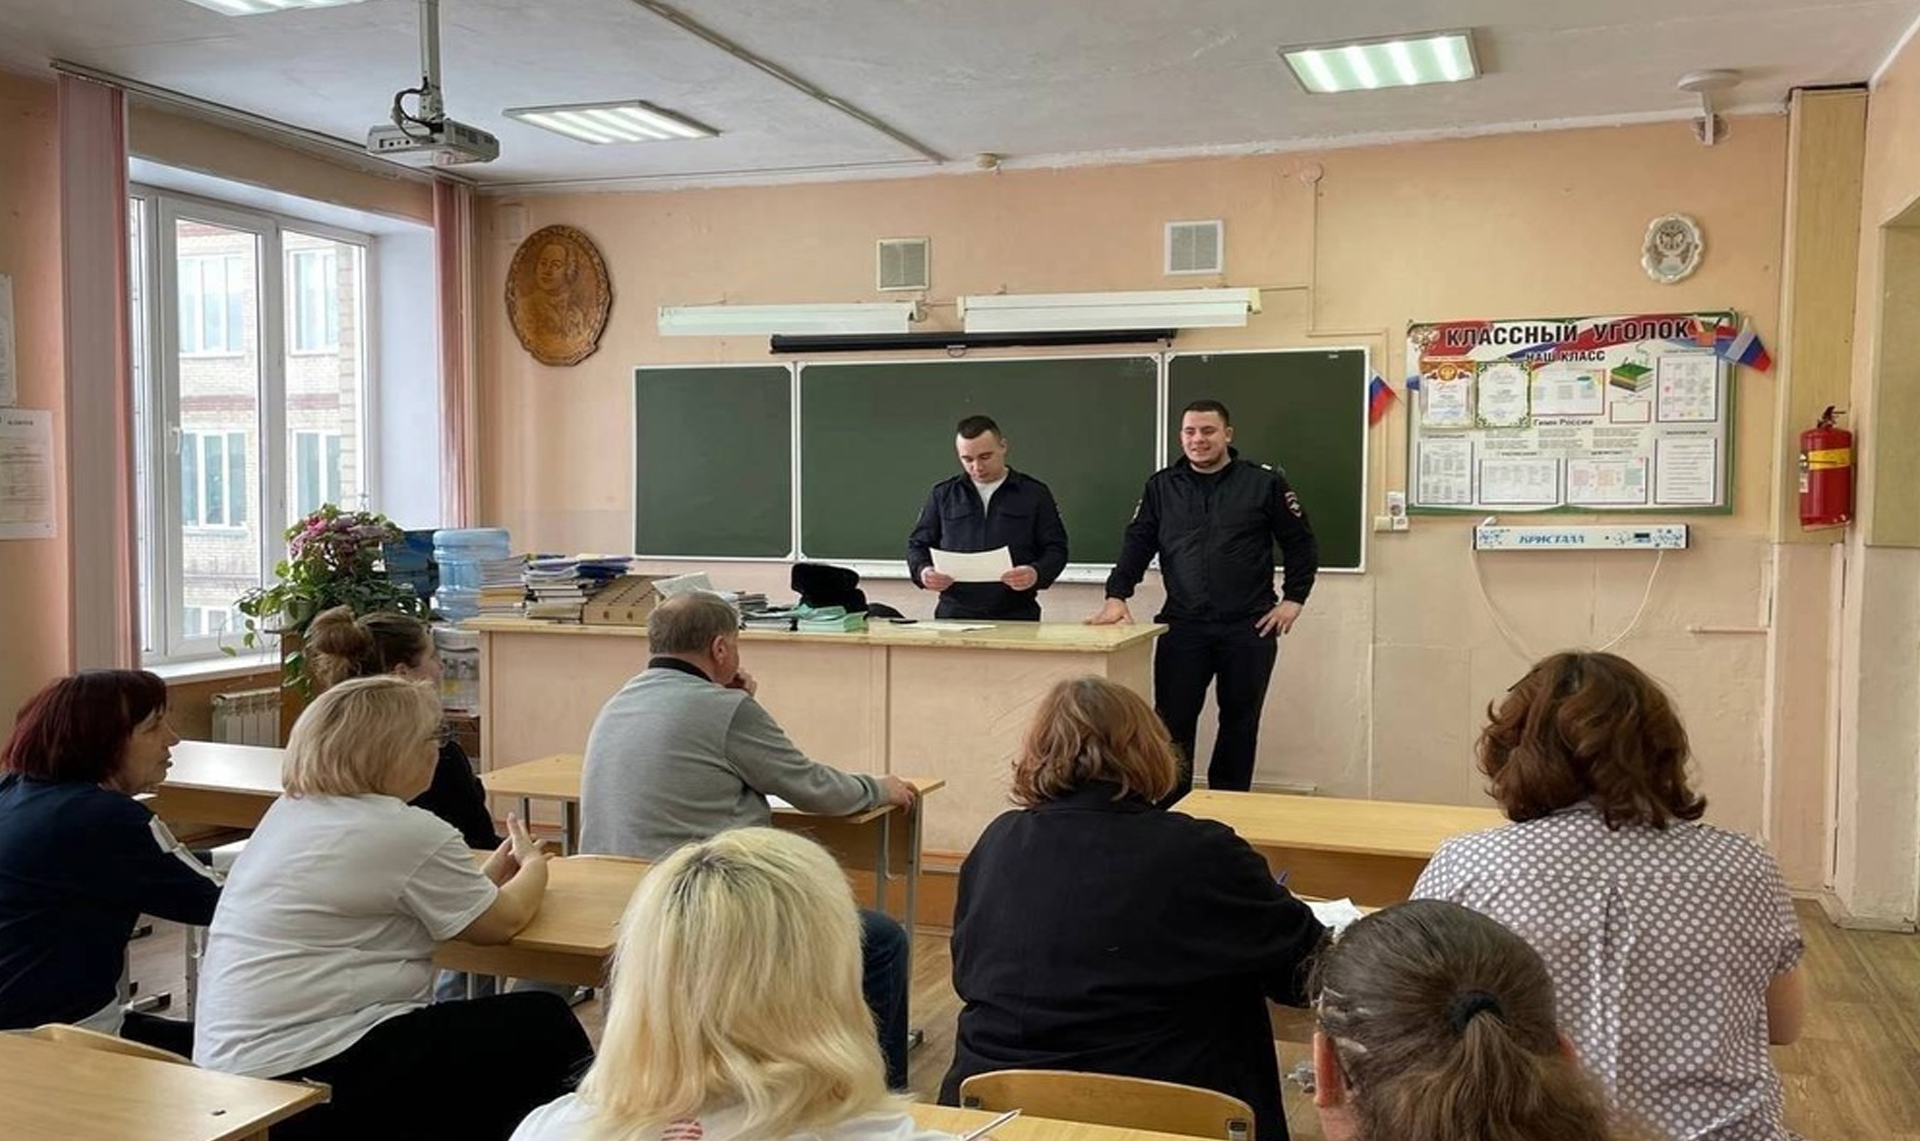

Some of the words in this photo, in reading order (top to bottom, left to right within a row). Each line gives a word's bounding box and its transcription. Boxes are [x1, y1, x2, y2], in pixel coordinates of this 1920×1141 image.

[1447, 320, 1577, 346] КЛАССНЫЙ
[1593, 319, 1689, 341] УГОЛОК
[1526, 352, 1555, 363] НАШ
[1561, 350, 1606, 363] КЛАСС
[1560, 418, 1594, 426] России
